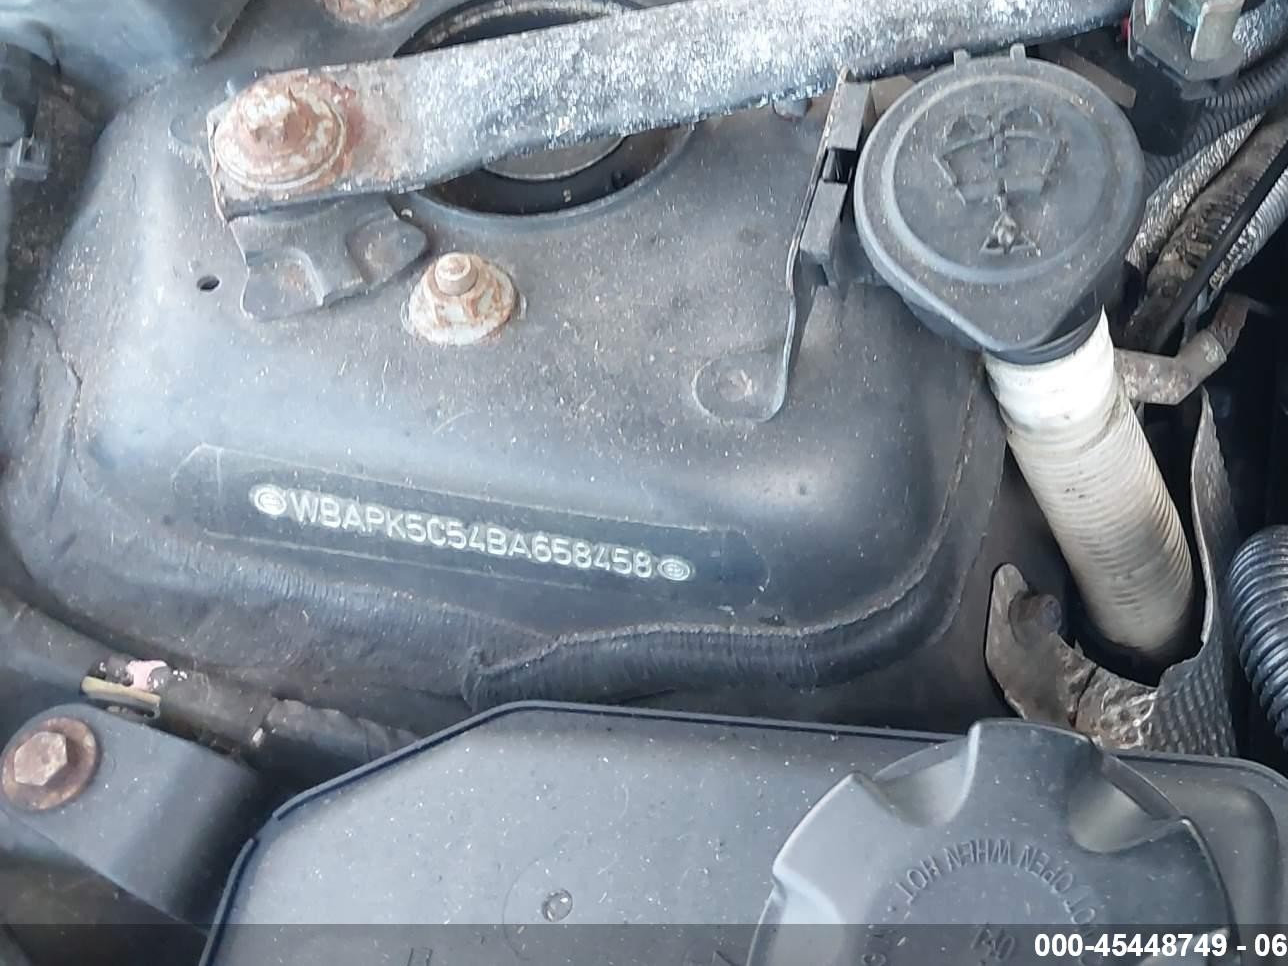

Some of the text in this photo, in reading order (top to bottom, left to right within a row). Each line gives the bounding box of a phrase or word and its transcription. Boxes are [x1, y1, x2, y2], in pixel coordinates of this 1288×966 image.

[289, 490, 653, 580] WBAPK5C54BA658458
[894, 852, 944, 907] HOT
[942, 838, 1013, 873] WHEN
[1015, 842, 1075, 896] OPEN
